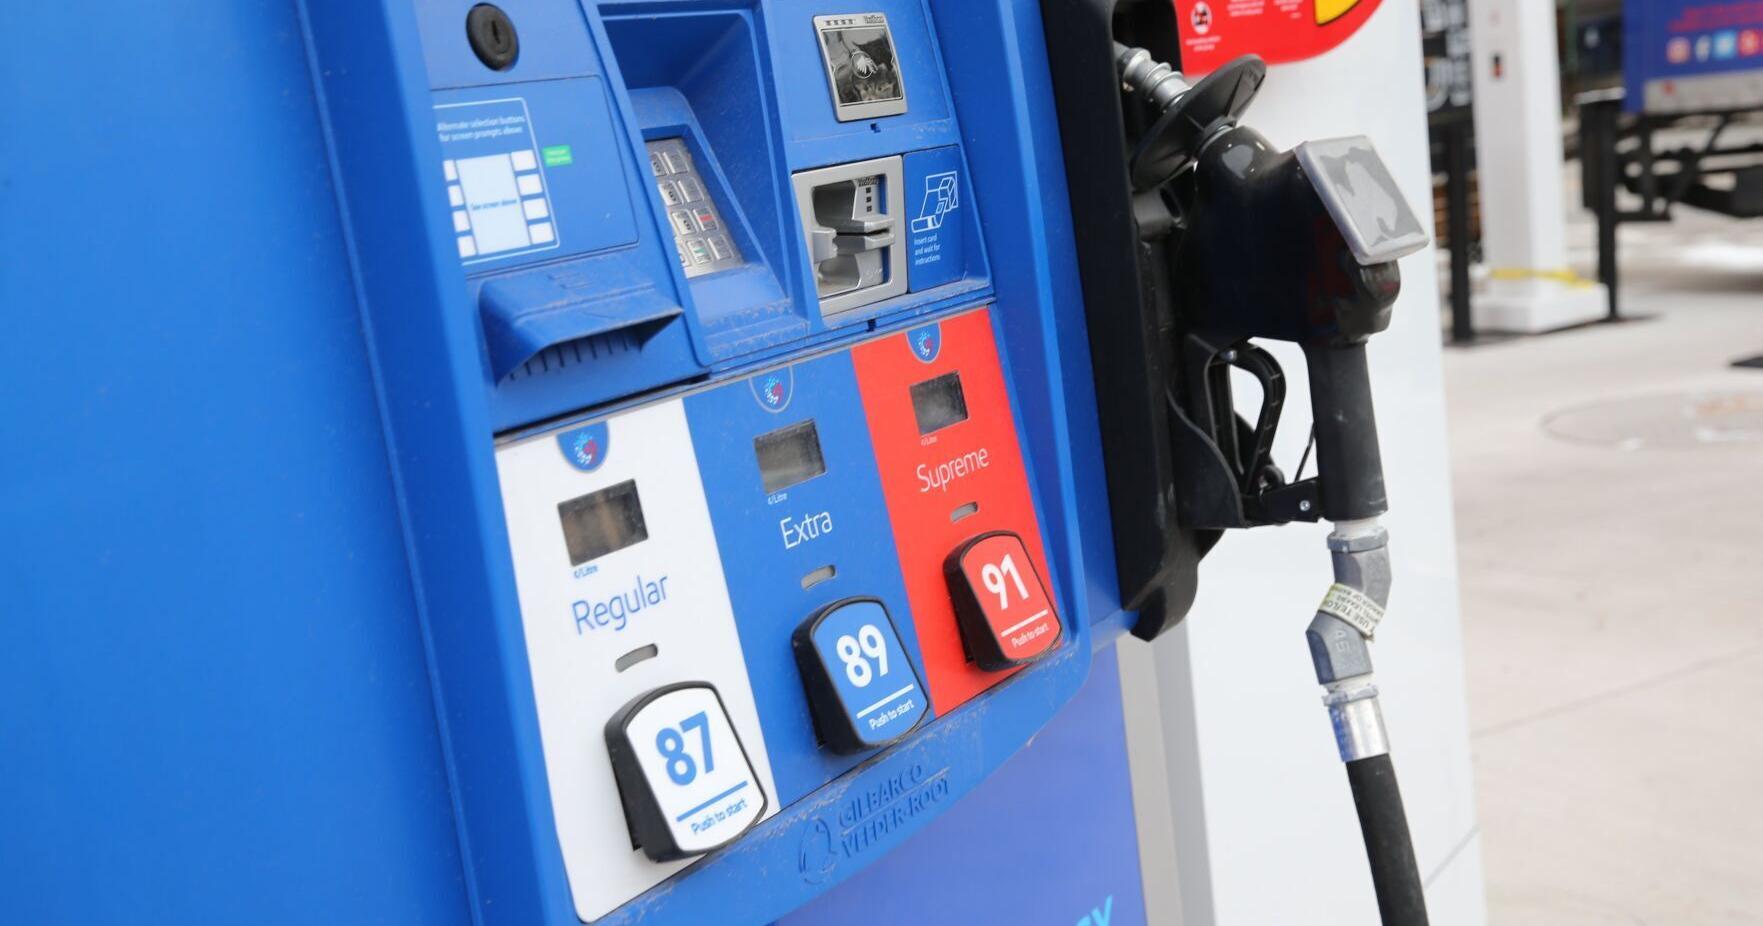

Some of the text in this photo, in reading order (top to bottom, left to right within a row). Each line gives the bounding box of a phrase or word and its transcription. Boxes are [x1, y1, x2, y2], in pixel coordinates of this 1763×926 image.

[916, 448, 990, 492] Supreme
[780, 511, 833, 550] Extra
[572, 575, 669, 635] Regular
[981, 553, 1030, 610] 91
[836, 624, 888, 688] 89
[1011, 623, 1050, 648] Push to start
[868, 699, 915, 730] Push to start
[655, 709, 715, 786] 87
[690, 797, 749, 835] Push to start
[840, 765, 922, 827] GILBARCO
[842, 778, 949, 858] VEEDER-ROOT
